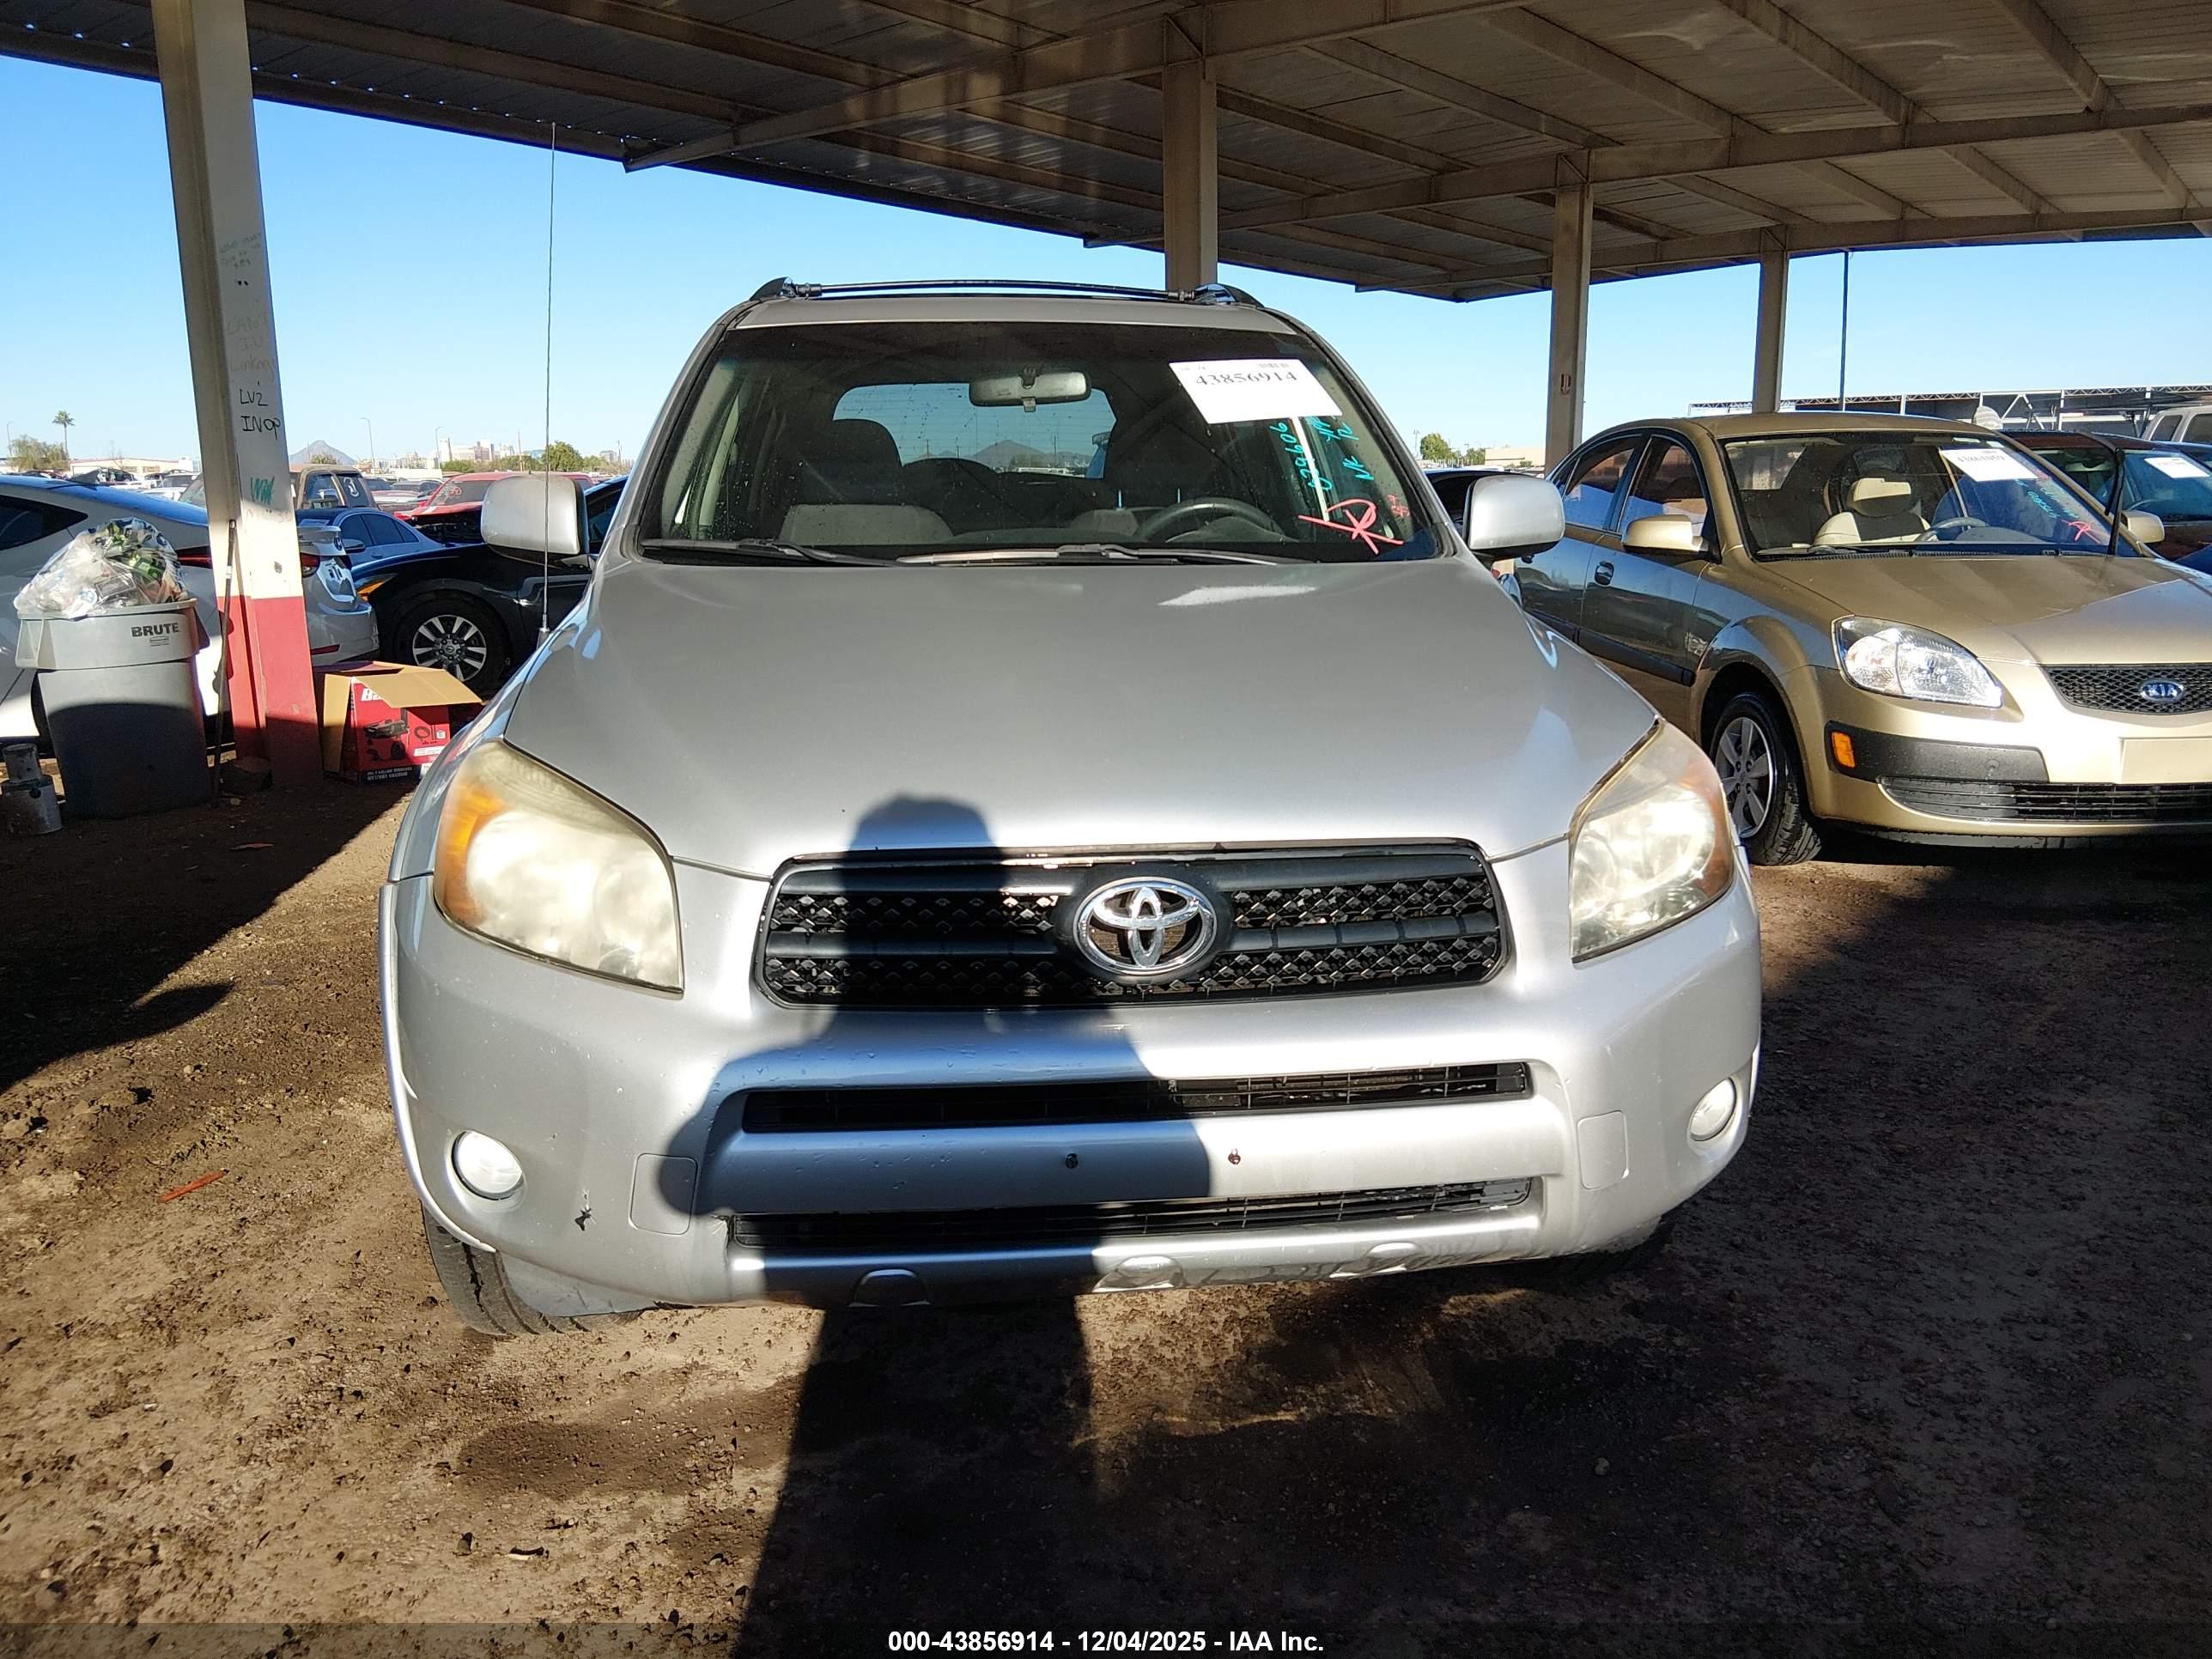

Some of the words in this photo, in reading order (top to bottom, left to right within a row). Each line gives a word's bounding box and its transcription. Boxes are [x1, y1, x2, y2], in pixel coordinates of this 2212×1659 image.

[1196, 371, 1297, 386] 43856914
[131, 622, 179, 637] BRUTE
[2148, 684, 2178, 696] KIA
